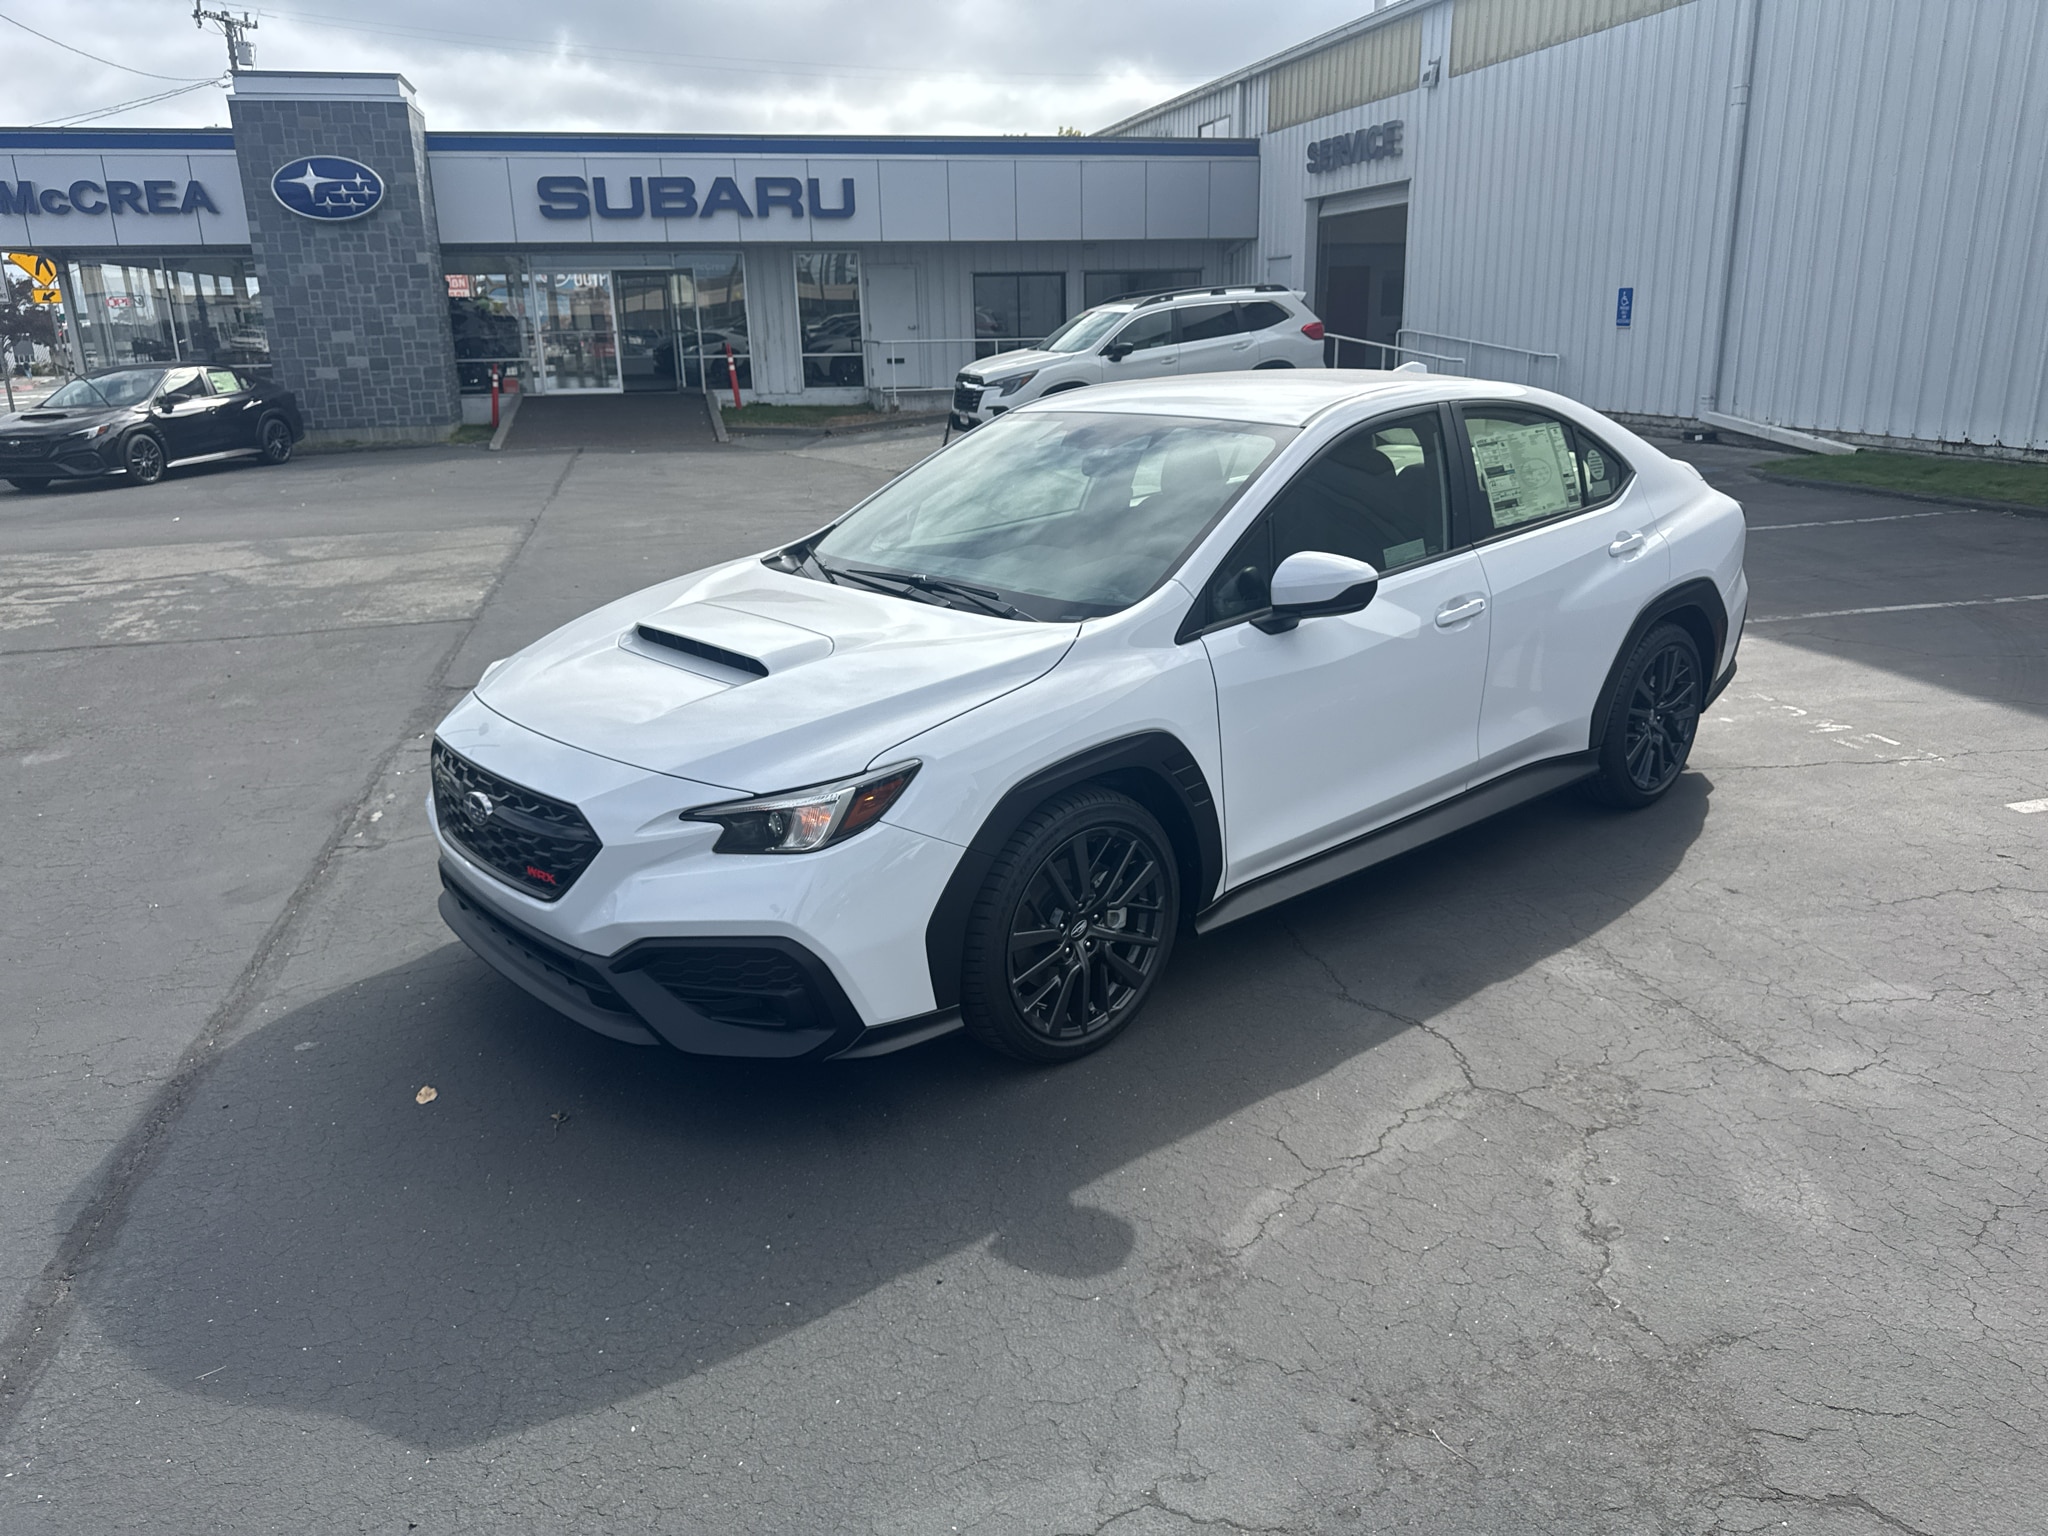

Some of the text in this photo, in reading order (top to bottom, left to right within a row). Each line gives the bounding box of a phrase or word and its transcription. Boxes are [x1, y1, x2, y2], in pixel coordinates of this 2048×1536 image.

[1306, 119, 1404, 174] SERVICE
[0, 180, 220, 216] McCREA
[536, 176, 856, 219] SUBARU
[526, 865, 556, 885] WRX
